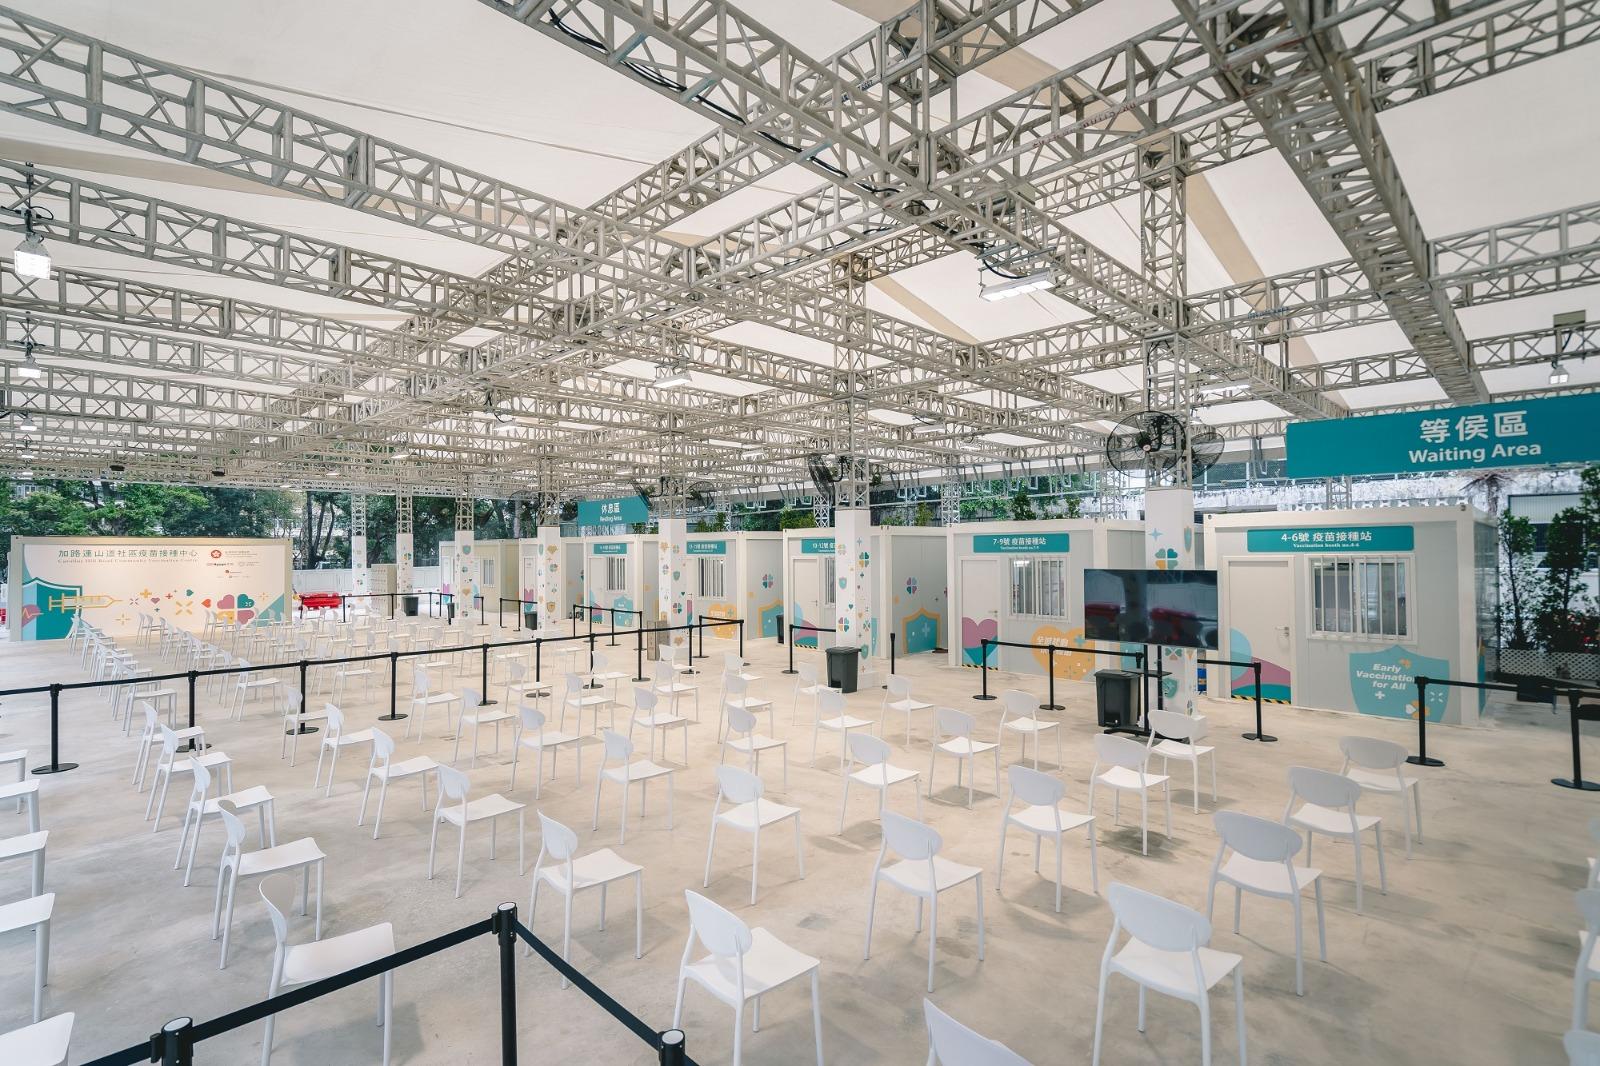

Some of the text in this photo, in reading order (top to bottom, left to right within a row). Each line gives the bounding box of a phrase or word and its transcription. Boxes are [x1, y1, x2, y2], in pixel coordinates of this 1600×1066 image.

[1420, 410, 1528, 443] 等侯區
[1408, 443, 1541, 464] Waiting Area
[1281, 531, 1372, 542] 4-6號 疫苗接種站
[1373, 663, 1401, 674] Early
[1372, 680, 1406, 690] for All
